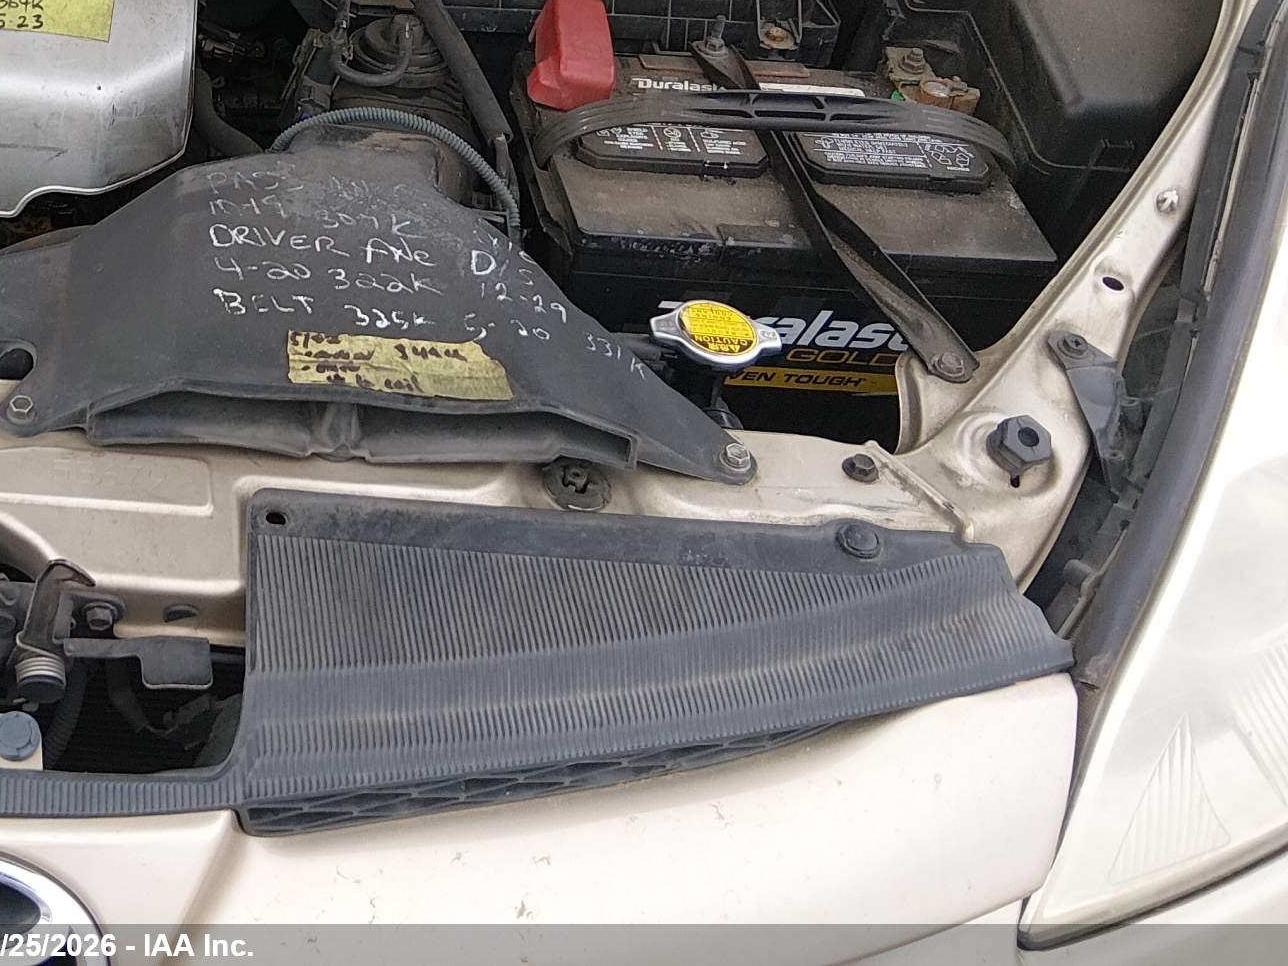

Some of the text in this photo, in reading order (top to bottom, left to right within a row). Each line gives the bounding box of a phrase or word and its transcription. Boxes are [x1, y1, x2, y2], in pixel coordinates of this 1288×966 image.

[209, 224, 351, 258] DRIVER
[213, 288, 314, 314] BELT
[695, 334, 749, 347] CAUTION
[783, 373, 864, 388] TOUGH
